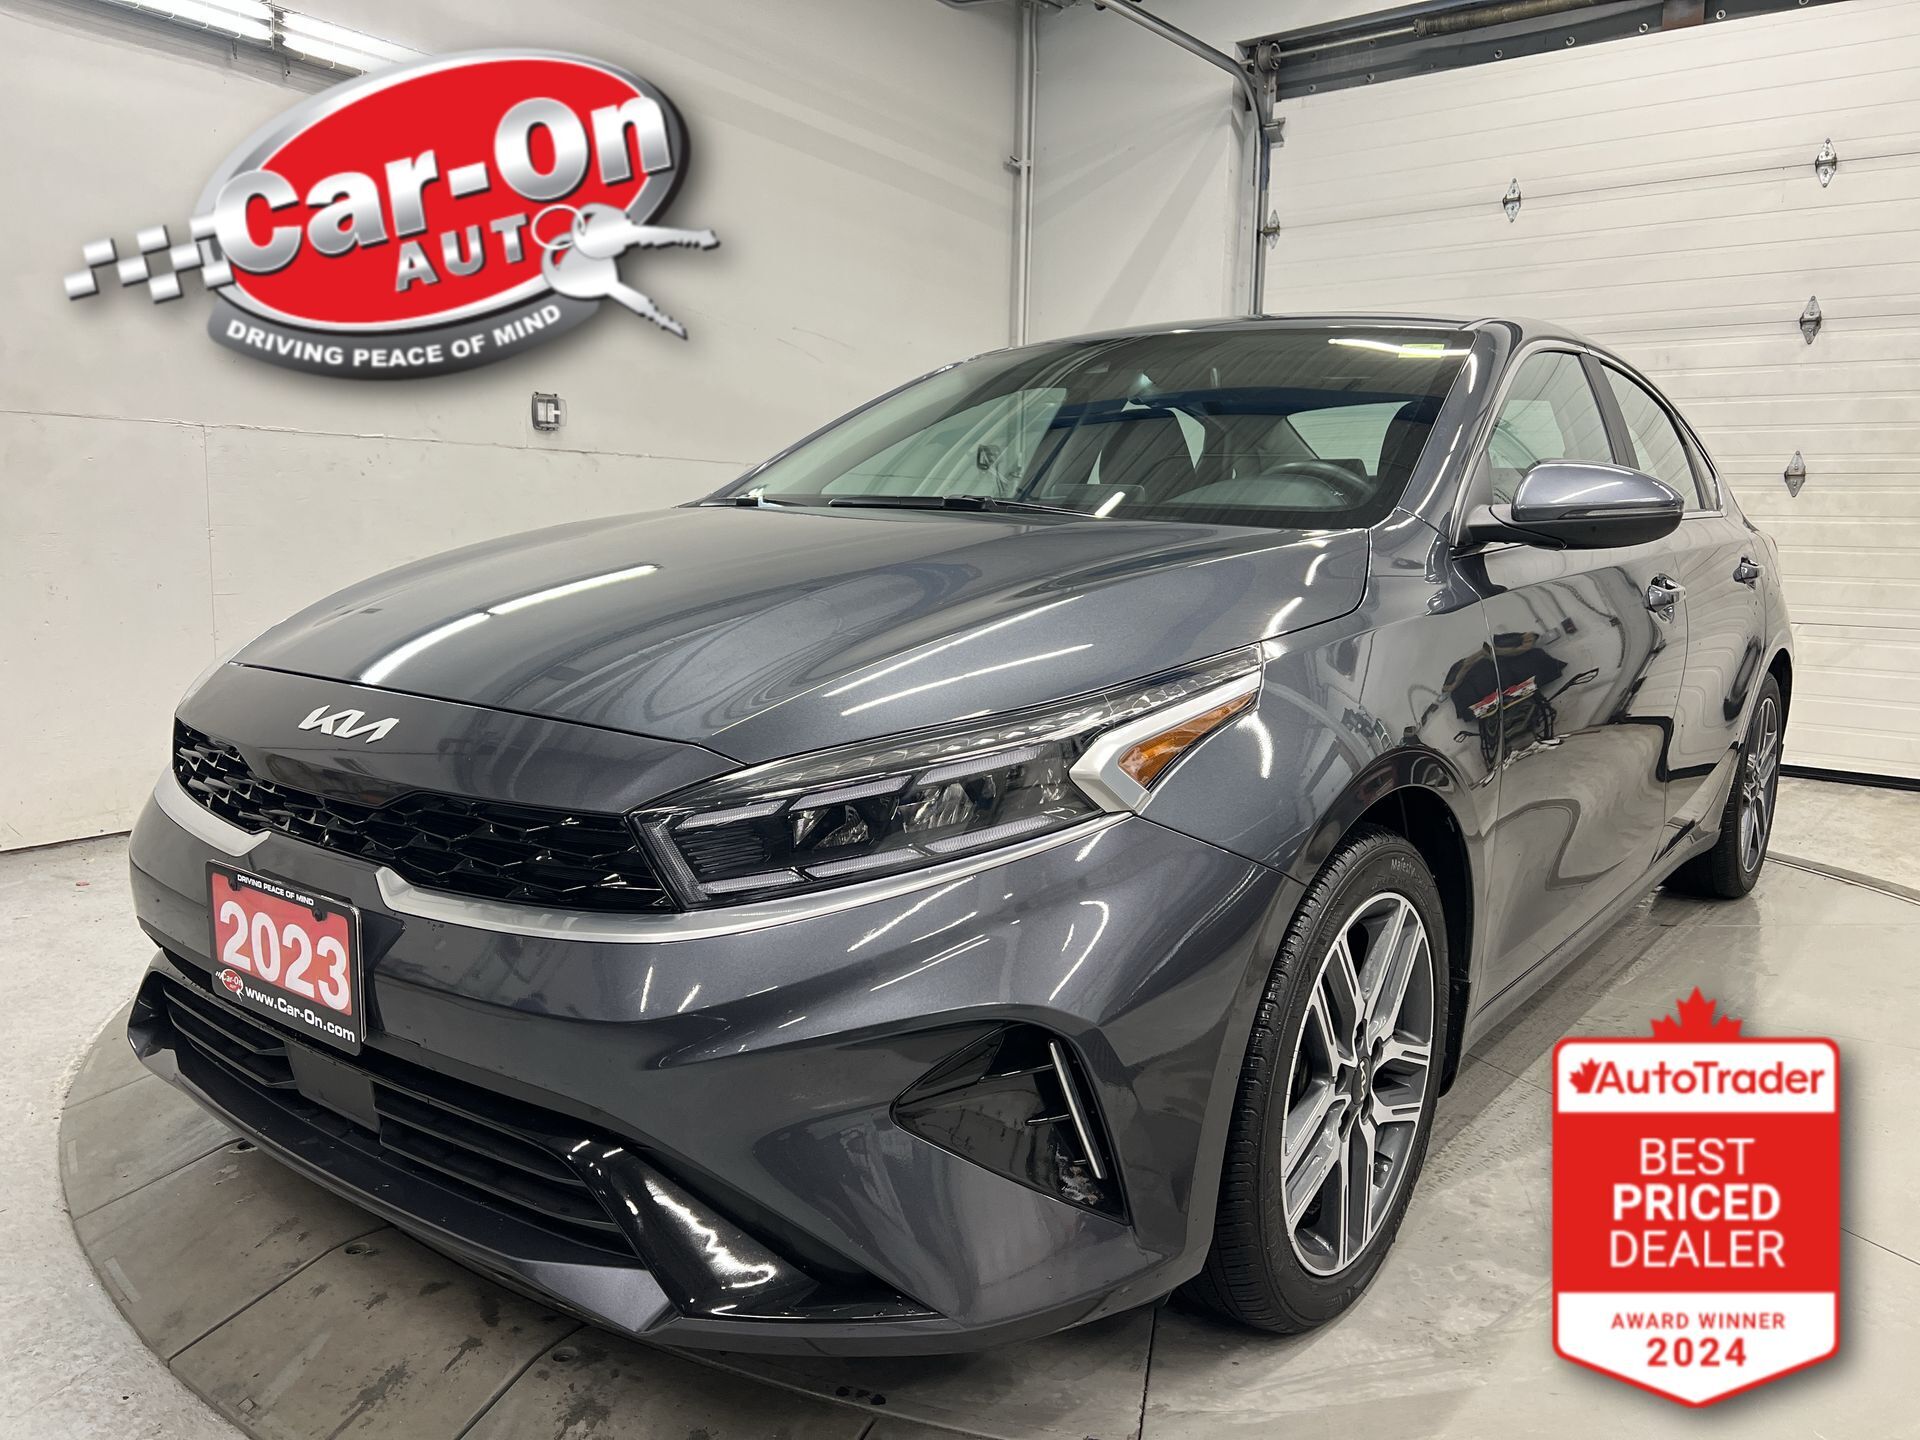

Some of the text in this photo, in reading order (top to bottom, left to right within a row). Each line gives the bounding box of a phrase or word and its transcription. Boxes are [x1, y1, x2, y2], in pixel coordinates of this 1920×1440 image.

[297, 704, 400, 744] KIA
[237, 874, 315, 907] DRIVING PEACE OF MIND
[220, 901, 350, 1011] 2023
[245, 986, 355, 1042] www.Car-On.com
